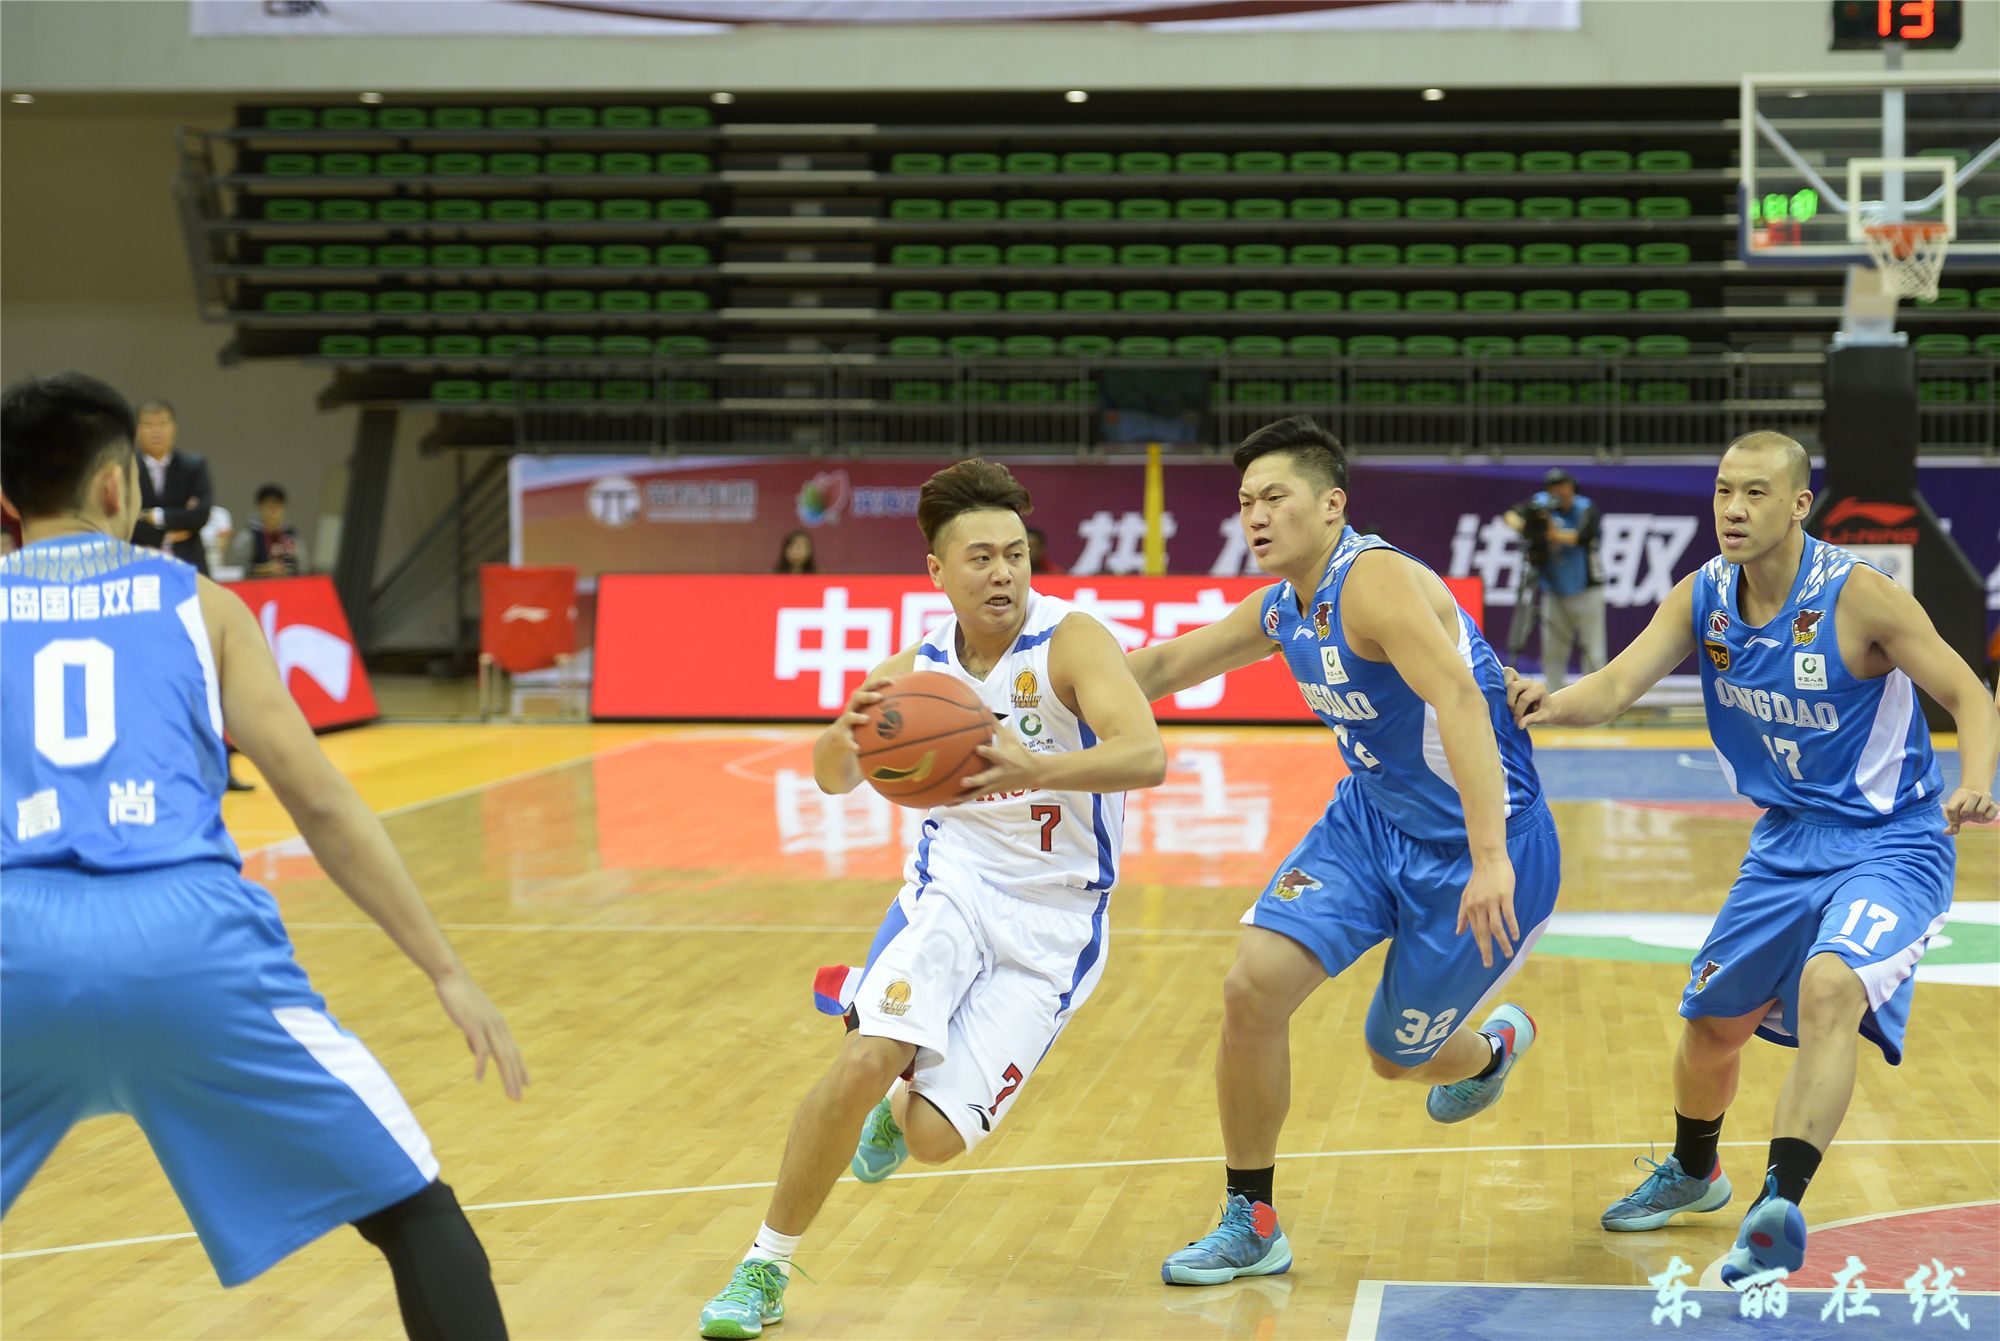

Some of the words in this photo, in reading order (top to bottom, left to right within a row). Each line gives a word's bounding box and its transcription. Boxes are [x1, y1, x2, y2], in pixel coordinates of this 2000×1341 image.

[1878, 0, 1935, 39] 13
[0, 575, 161, 623] 岛国信双星
[34, 637, 117, 768] 0
[1762, 734, 1804, 780] 17
[1030, 804, 1062, 852] 7
[1839, 898, 1900, 951] 17
[1394, 1007, 1459, 1046] 32
[988, 1062, 1024, 1117] 7
